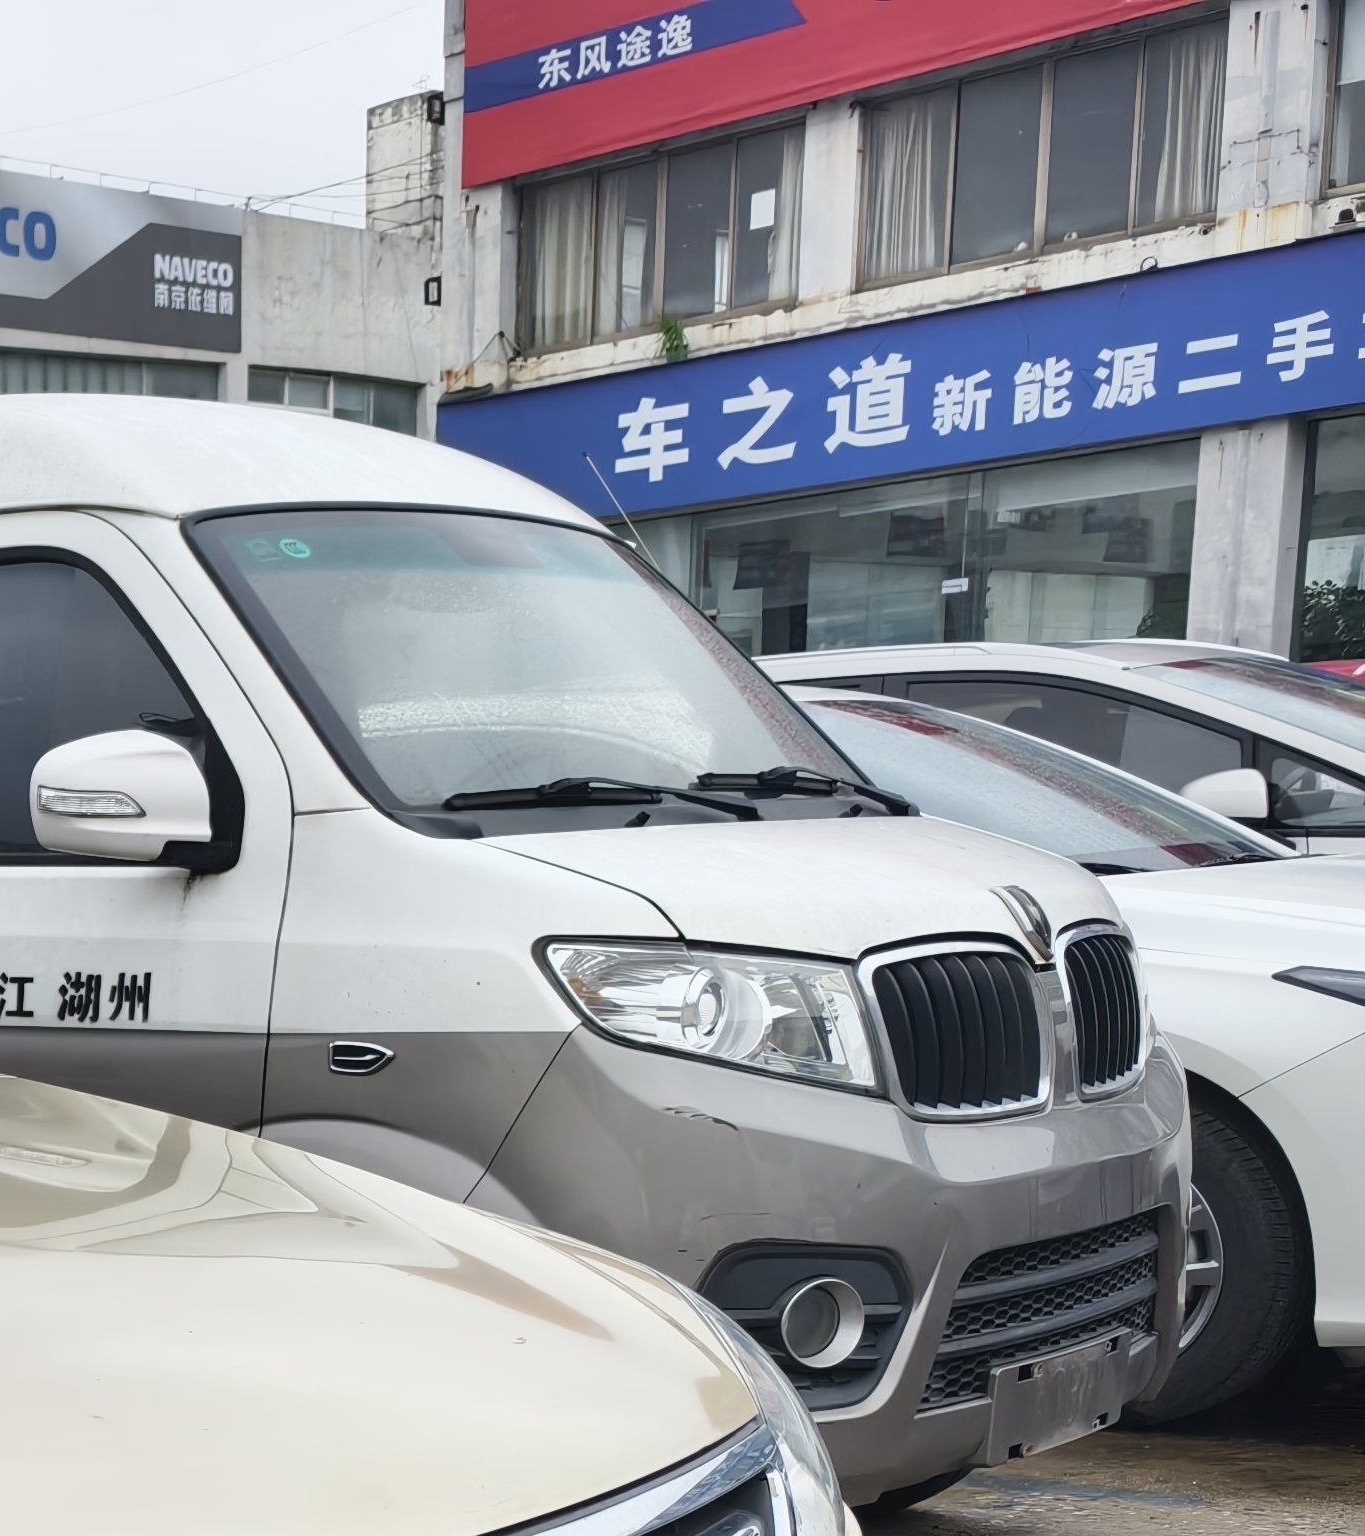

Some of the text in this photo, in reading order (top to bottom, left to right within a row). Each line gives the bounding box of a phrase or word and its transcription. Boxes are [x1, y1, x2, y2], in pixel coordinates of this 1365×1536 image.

[537, 14, 693, 90] 东风途逸
[154, 254, 234, 288] NAVECO
[154, 282, 234, 316] 南京依维柯
[614, 310, 1365, 483] 车之道 新能源二手
[57, 971, 152, 1024] 湖州
